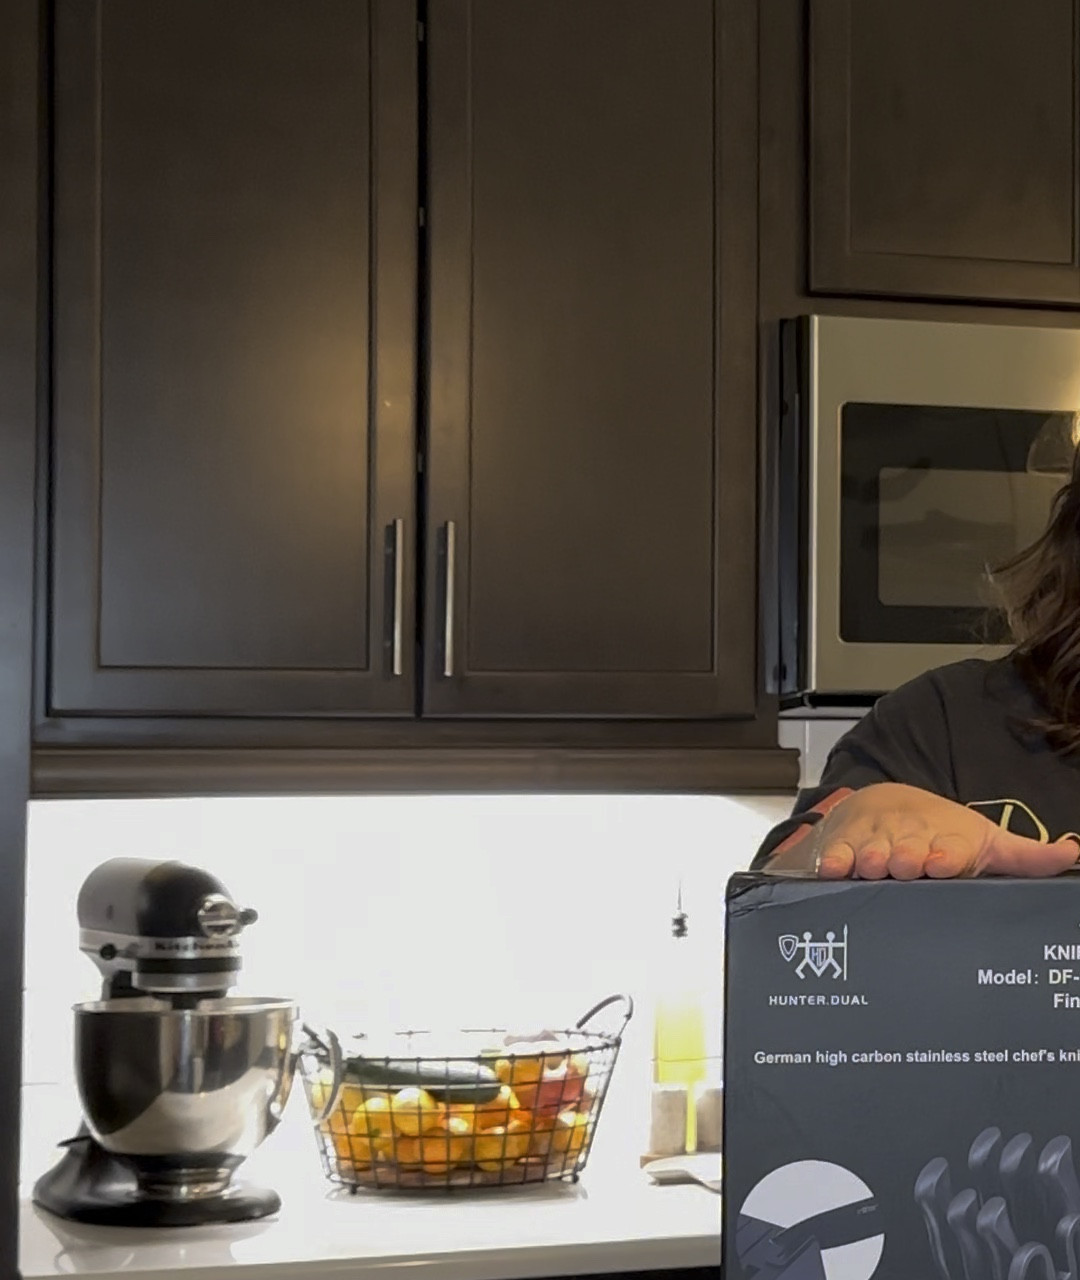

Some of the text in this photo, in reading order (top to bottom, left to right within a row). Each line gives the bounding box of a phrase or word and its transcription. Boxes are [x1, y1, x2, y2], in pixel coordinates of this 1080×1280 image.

[977, 968, 1039, 985] Model:
[754, 1050, 812, 1065] German
[815, 1050, 848, 1067] high
[851, 1049, 901, 1064] carbon
[905, 1048, 971, 1064] stainless
[974, 1048, 1009, 1063] steel
[1012, 1048, 1056, 1063] chef's
